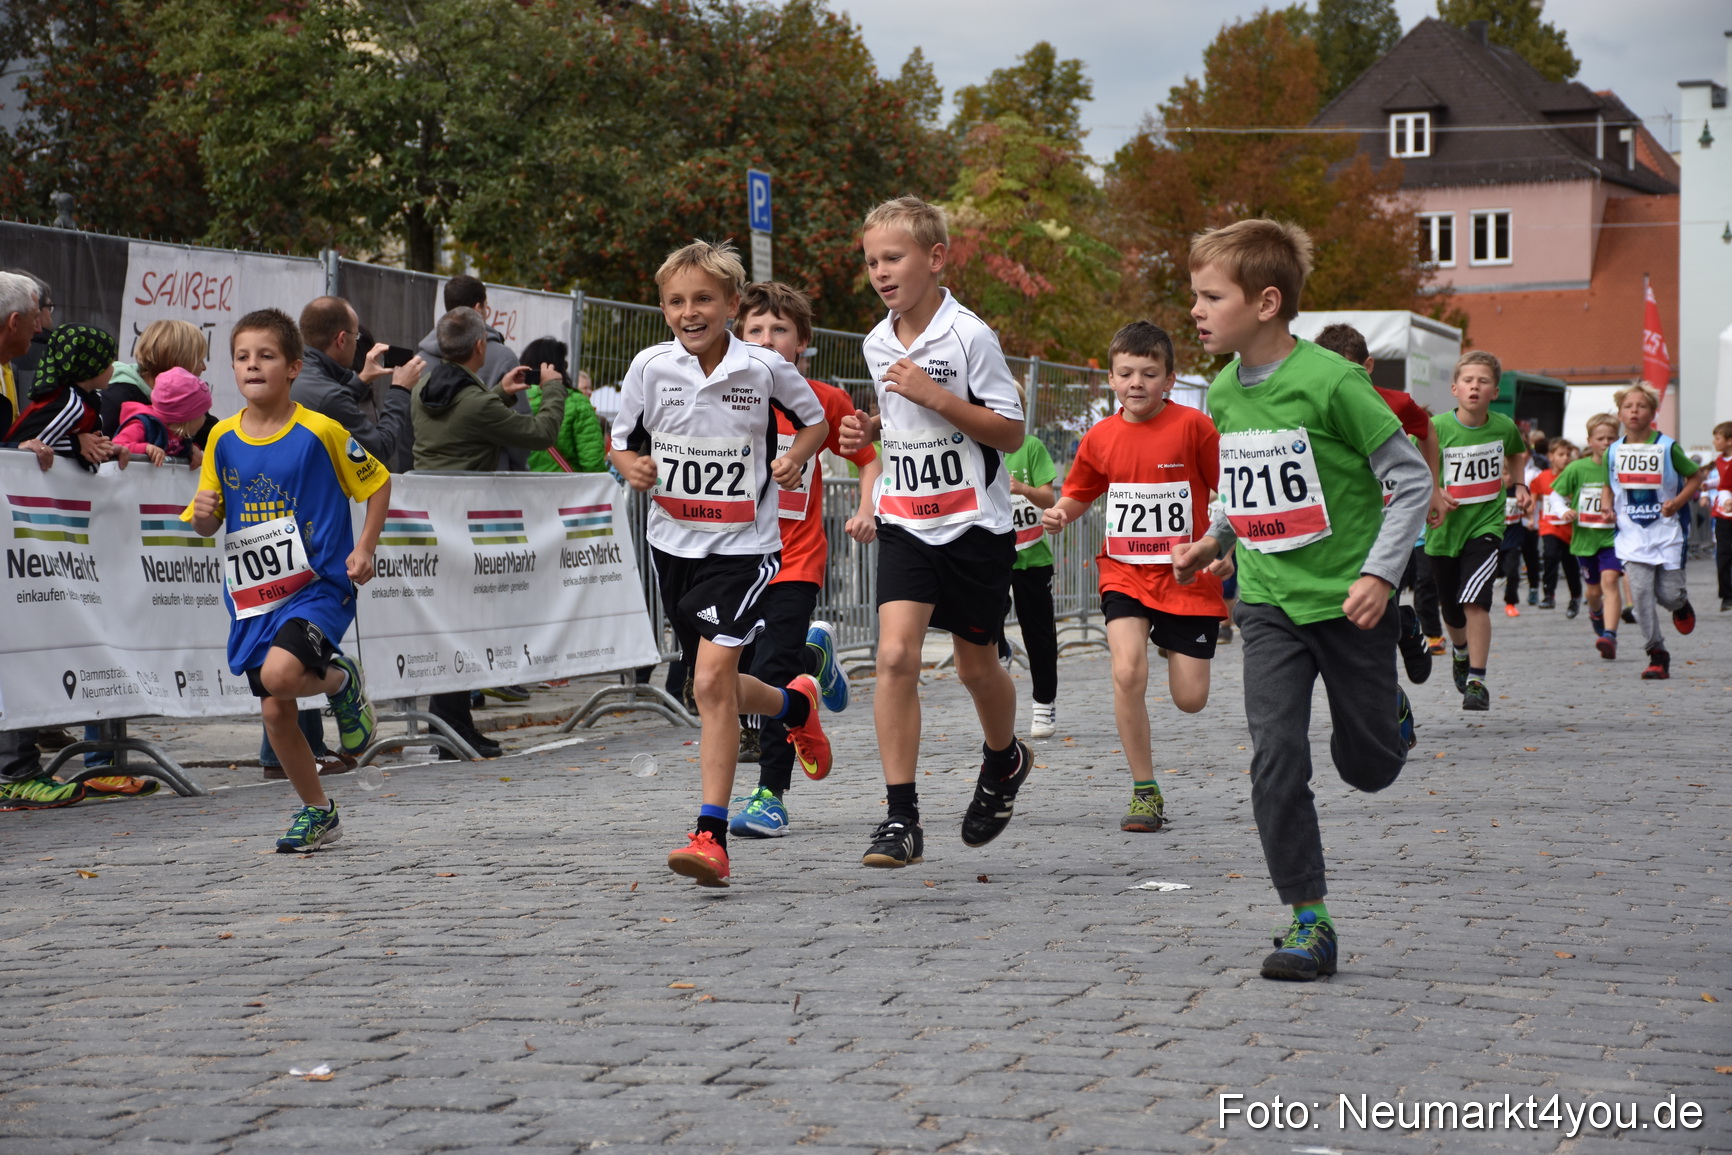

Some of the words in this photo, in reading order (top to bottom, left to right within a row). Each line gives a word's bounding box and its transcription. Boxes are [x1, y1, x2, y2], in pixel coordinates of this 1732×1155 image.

[753, 179, 766, 223] P
[661, 398, 685, 406] Lukas
[722, 394, 761, 404] MÜNCH
[655, 442, 685, 454] PARTL
[688, 447, 737, 456] Neumarkt
[884, 440, 901, 449] PARTL
[902, 438, 948, 450] Neumarkt
[1221, 449, 1238, 460] PARTL
[1240, 446, 1287, 459] Neumarkt
[1467, 448, 1495, 458] Neumarkt
[890, 450, 963, 491] 7040
[1450, 456, 1499, 482] 7405
[1620, 454, 1659, 472] 7059
[663, 457, 745, 496] 7022
[1224, 461, 1308, 508] 7216
[1109, 491, 1133, 499] PARTL
[1135, 491, 1176, 499] Neumarkt
[683, 504, 722, 519] Lukas
[912, 501, 939, 515] Luca
[1585, 497, 1601, 512] 70
[1013, 505, 1037, 527] 46
[1115, 502, 1185, 533] 7218
[1247, 519, 1286, 537] Jakob
[240, 529, 282, 546] Neumarkt
[1128, 541, 1170, 552] Vincent
[228, 539, 295, 585] 7097
[474, 550, 536, 575] NeuerMarkt
[560, 542, 622, 569] NeuerMarkt
[141, 555, 220, 583] NeuerMarkt
[600, 572, 622, 586] genießen
[17, 587, 66, 603] einkaufen
[258, 585, 288, 600] Felix
[372, 586, 398, 598] einkaufen
[152, 593, 180, 605] einkaufen
[196, 593, 219, 608] genießen
[82, 684, 122, 699] Neumarkt
